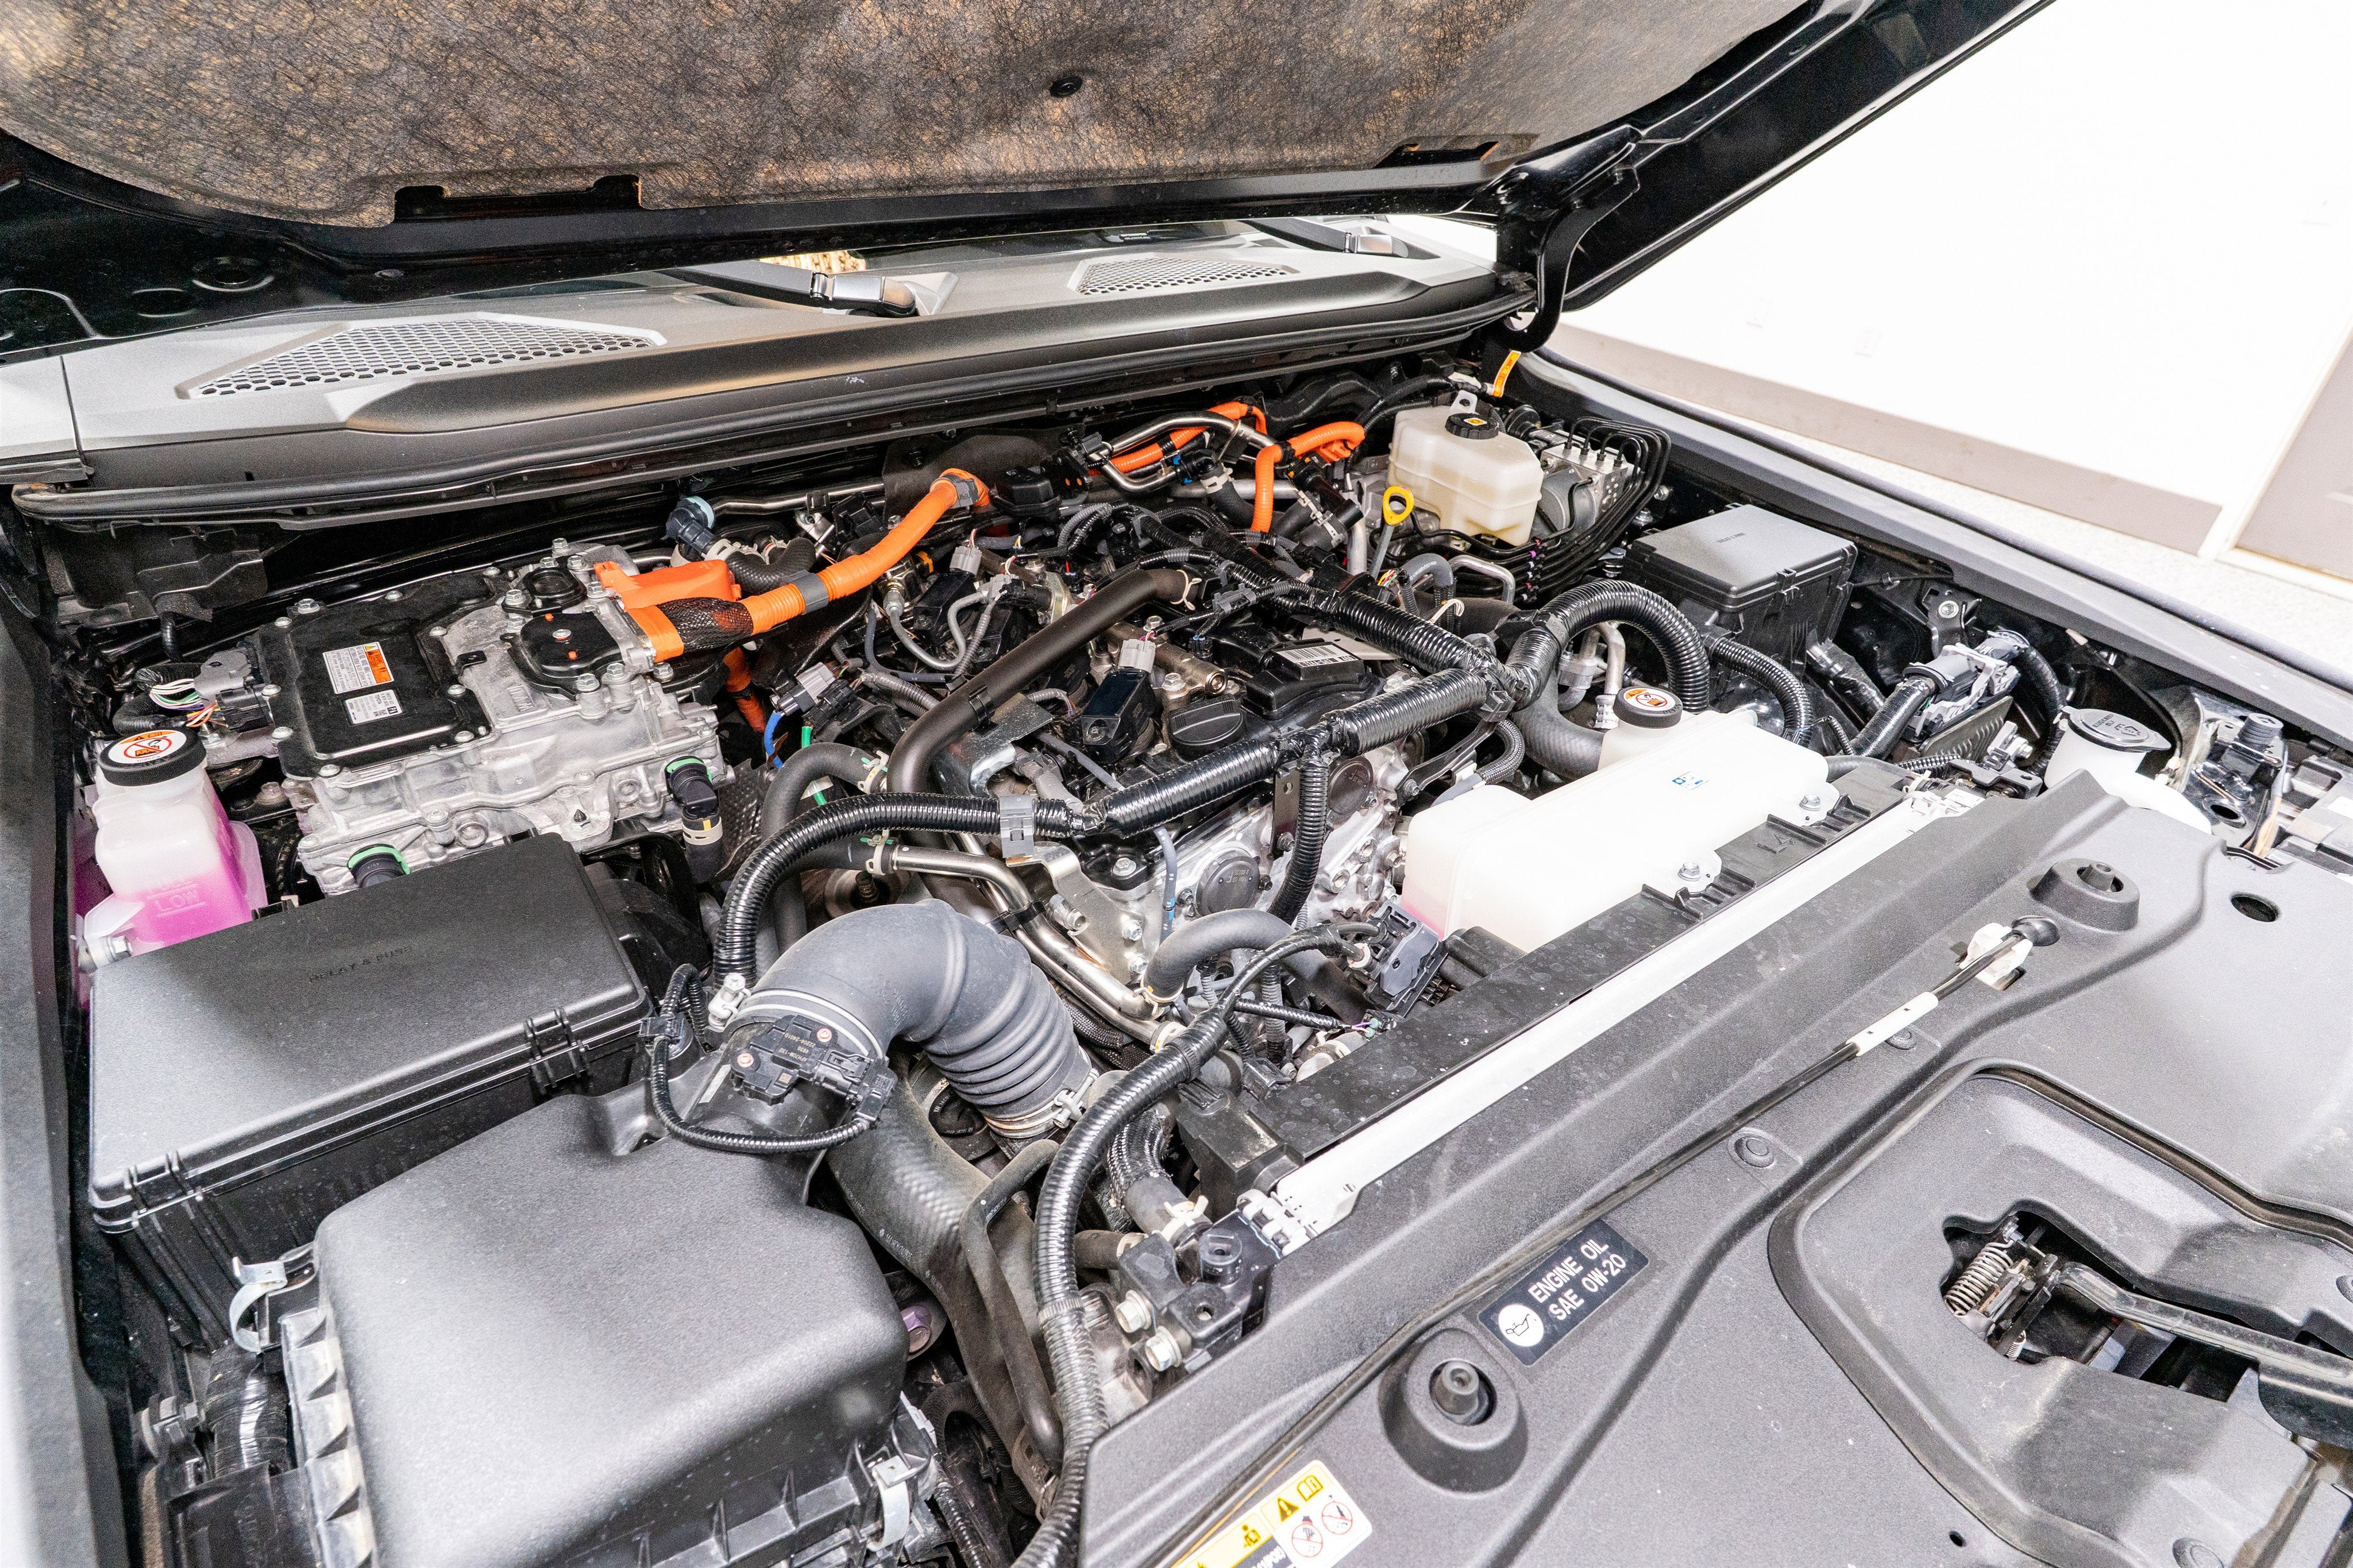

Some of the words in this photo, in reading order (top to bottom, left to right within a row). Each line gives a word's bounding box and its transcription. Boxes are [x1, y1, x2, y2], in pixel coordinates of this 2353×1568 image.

[1527, 1256, 1584, 1303] ENGINE
[1580, 1239, 1609, 1260] OIL
[1549, 1288, 1585, 1320] SAE
[1581, 1254, 1626, 1293] 0W-20
